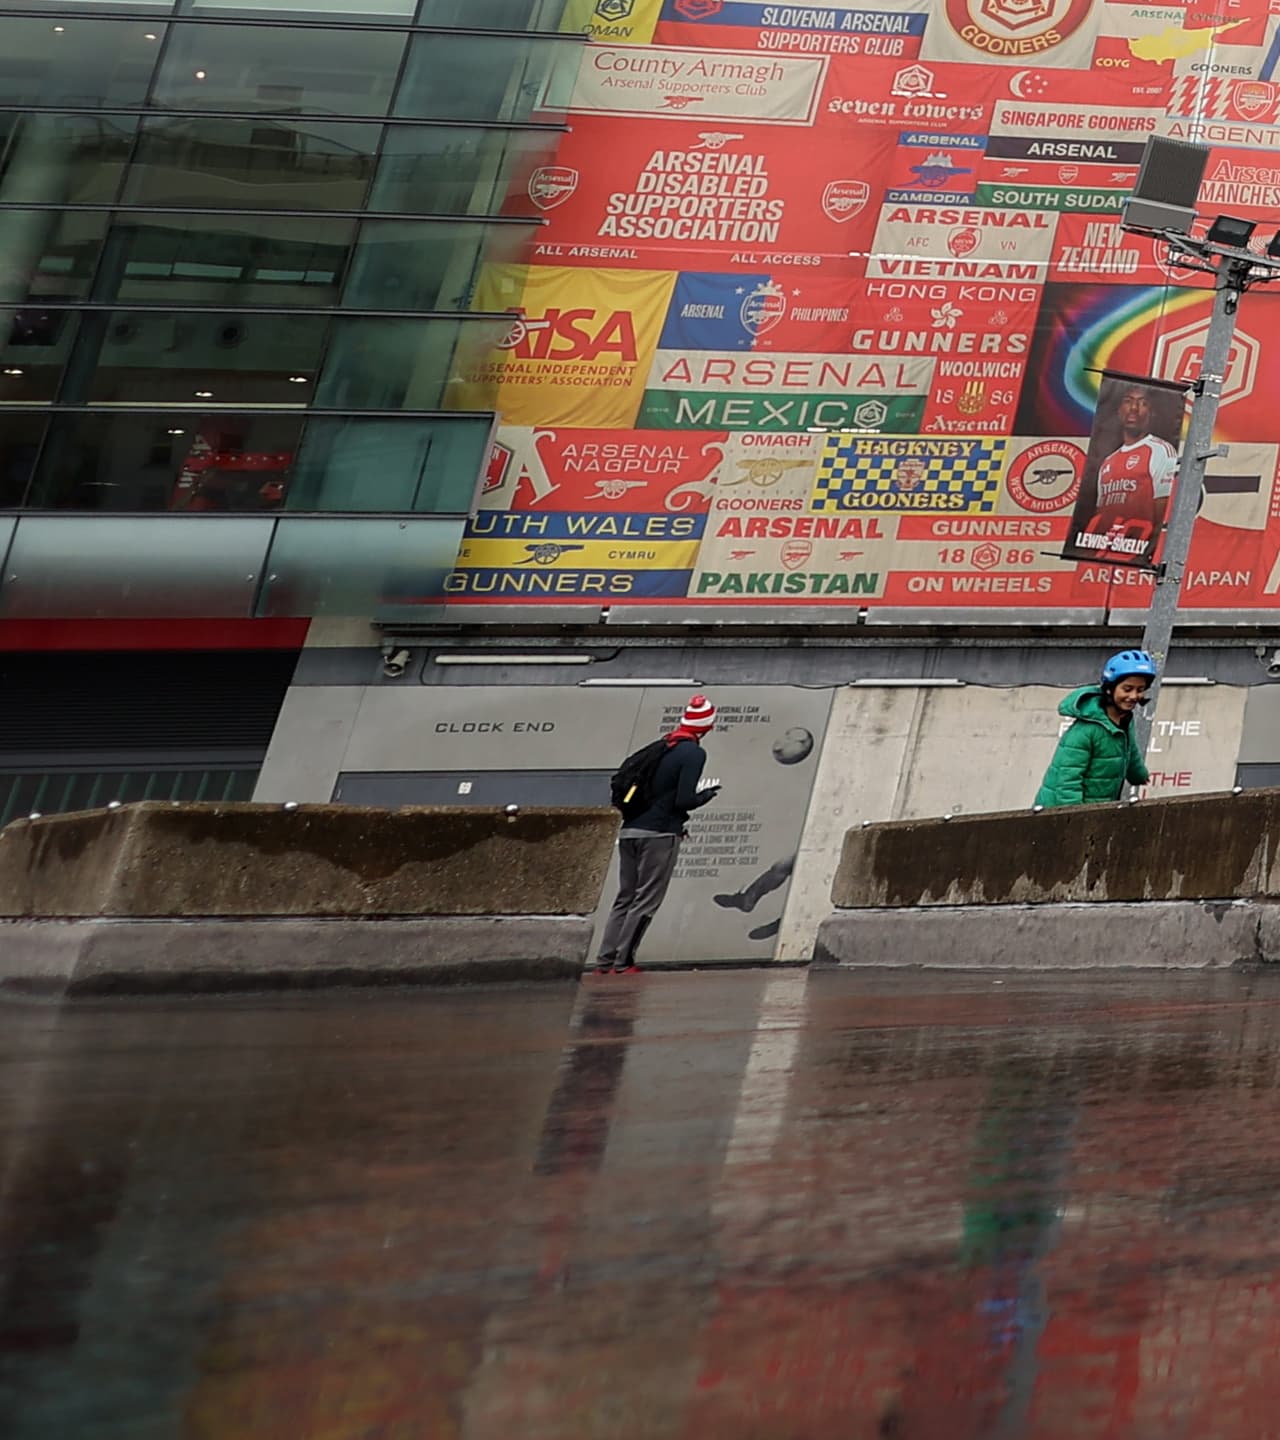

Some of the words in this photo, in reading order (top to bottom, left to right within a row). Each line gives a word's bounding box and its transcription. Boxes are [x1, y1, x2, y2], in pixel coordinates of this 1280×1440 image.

[761, 7, 836, 28] SLOVENIA
[840, 11, 911, 32] ARSENAL
[758, 32, 860, 53] SUPPORTERS
[864, 35, 904, 56] CLUB
[593, 51, 684, 75] County
[691, 60, 785, 82] Armagh
[601, 75, 654, 91] Arsenal
[657, 79, 730, 95] Supporters
[735, 83, 768, 96] Club
[1001, 110, 1083, 129] SINGAPORE
[1088, 114, 1156, 132] GOONERS
[645, 150, 768, 175] ARSENAL
[636, 173, 768, 198] DISABLED
[606, 195, 785, 220] SUPPORTERS
[597, 217, 779, 242] ASSOCIATION
[1086, 222, 1122, 247] NEW
[536, 245, 565, 257] ALL
[568, 246, 638, 258] ARSENAL
[731, 253, 758, 264] ALL
[762, 254, 821, 266] ACCESS
[1061, 244, 1140, 274] ZEALAND
[867, 284, 947, 299] HONG
[958, 286, 1036, 302] KONG
[853, 329, 1029, 353] GUNNERS
[562, 445, 689, 459] ARSENAL
[854, 439, 977, 458] HACKNEY
[564, 459, 680, 473] NAGPUR
[843, 491, 965, 510] GOONERS
[932, 520, 1051, 536] GUNNERS
[1076, 533, 1148, 555] LEWIS-SKELLY
[907, 577, 946, 592] ON
[951, 577, 1051, 592] WHEELS
[435, 722, 503, 733] CLOCK
[513, 721, 555, 733] END
